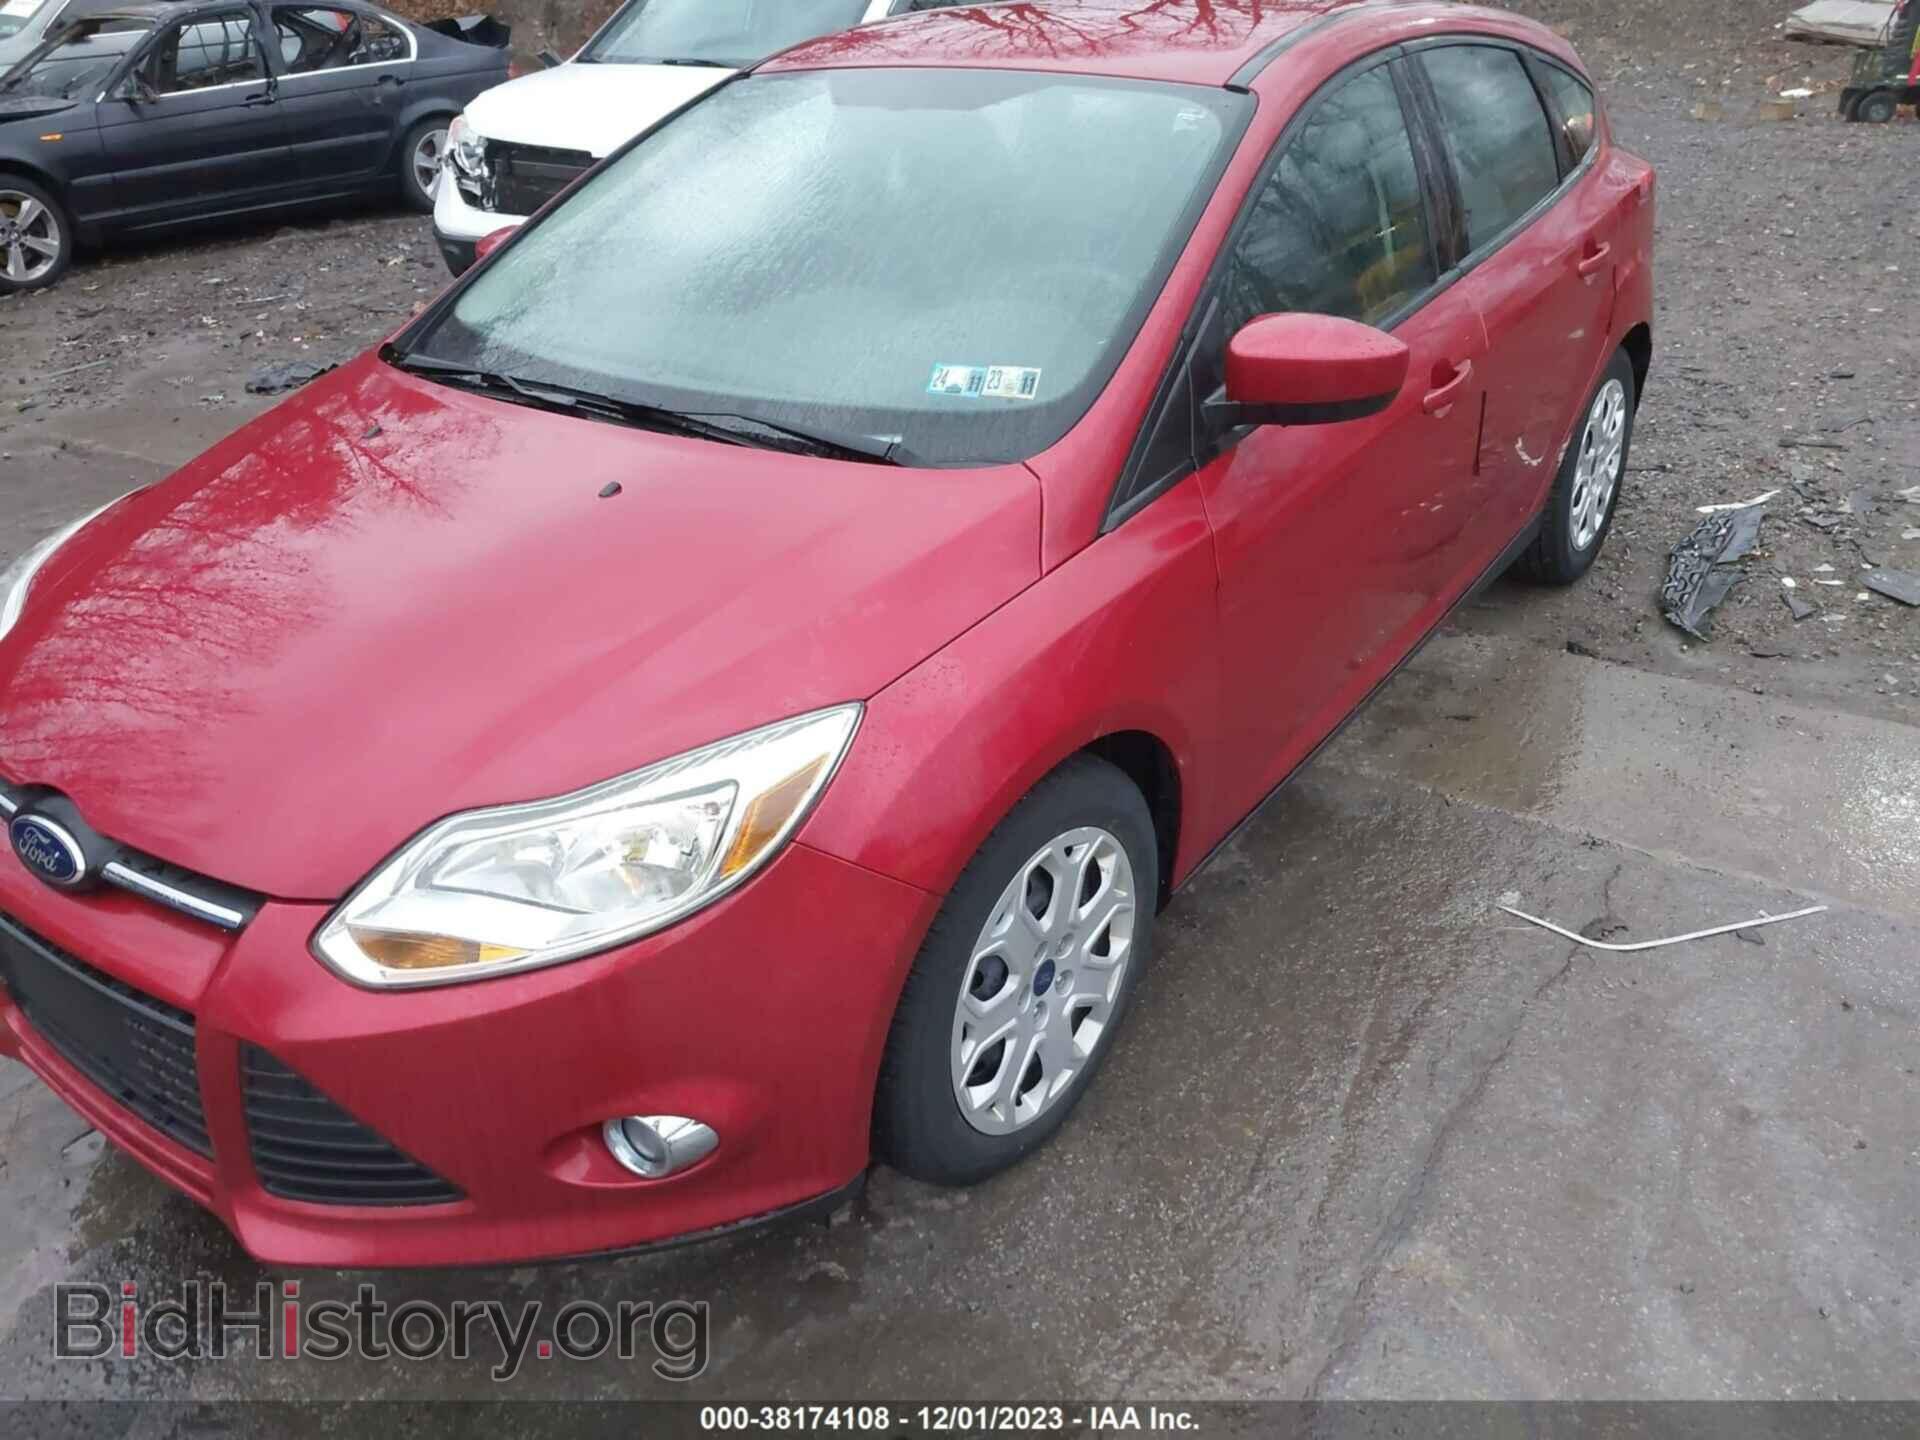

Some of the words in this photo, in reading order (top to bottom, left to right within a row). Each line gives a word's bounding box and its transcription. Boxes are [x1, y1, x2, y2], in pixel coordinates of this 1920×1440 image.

[933, 368, 949, 388] 24
[987, 369, 1003, 389] 23
[19, 826, 59, 872] Ford
